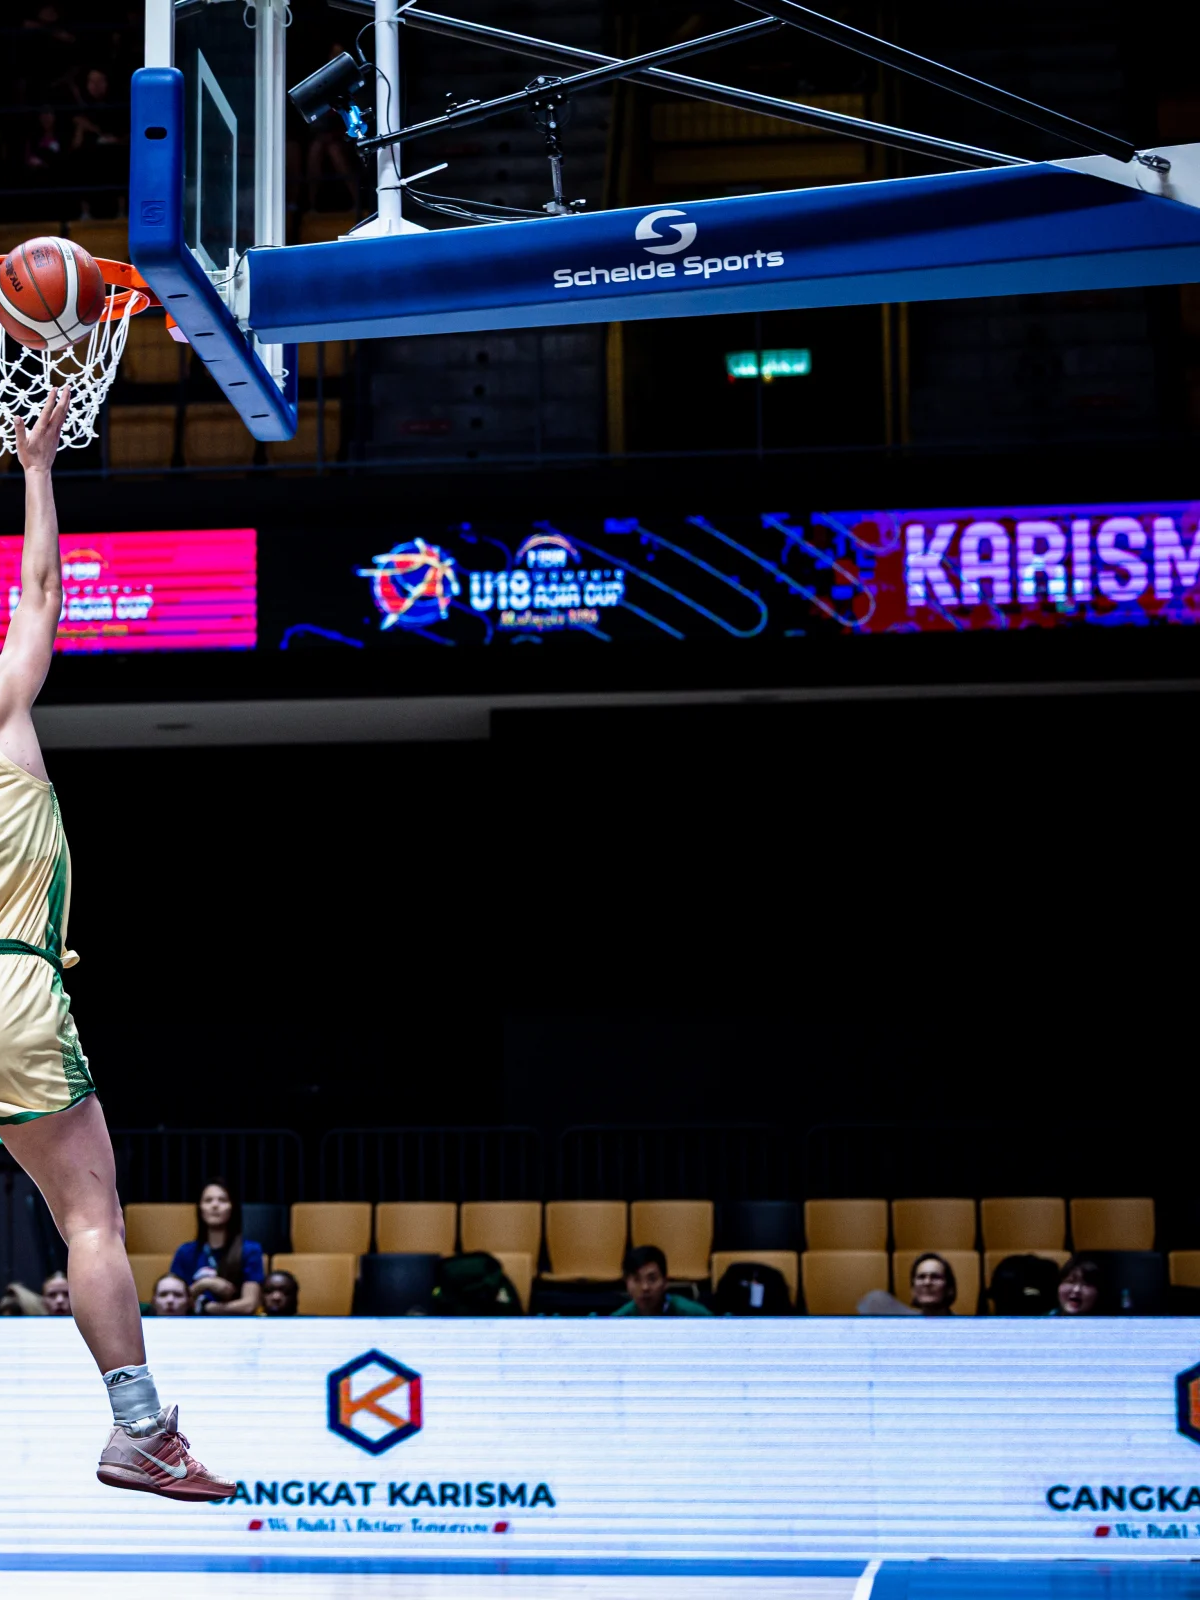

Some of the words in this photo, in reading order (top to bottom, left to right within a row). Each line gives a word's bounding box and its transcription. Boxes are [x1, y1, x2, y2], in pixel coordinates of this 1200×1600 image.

[553, 261, 676, 289] Schelde
[683, 250, 784, 279] Sports
[469, 570, 531, 611] U18
[208, 1480, 377, 1506] ANGKAT
[388, 1482, 556, 1508] KARISMA
